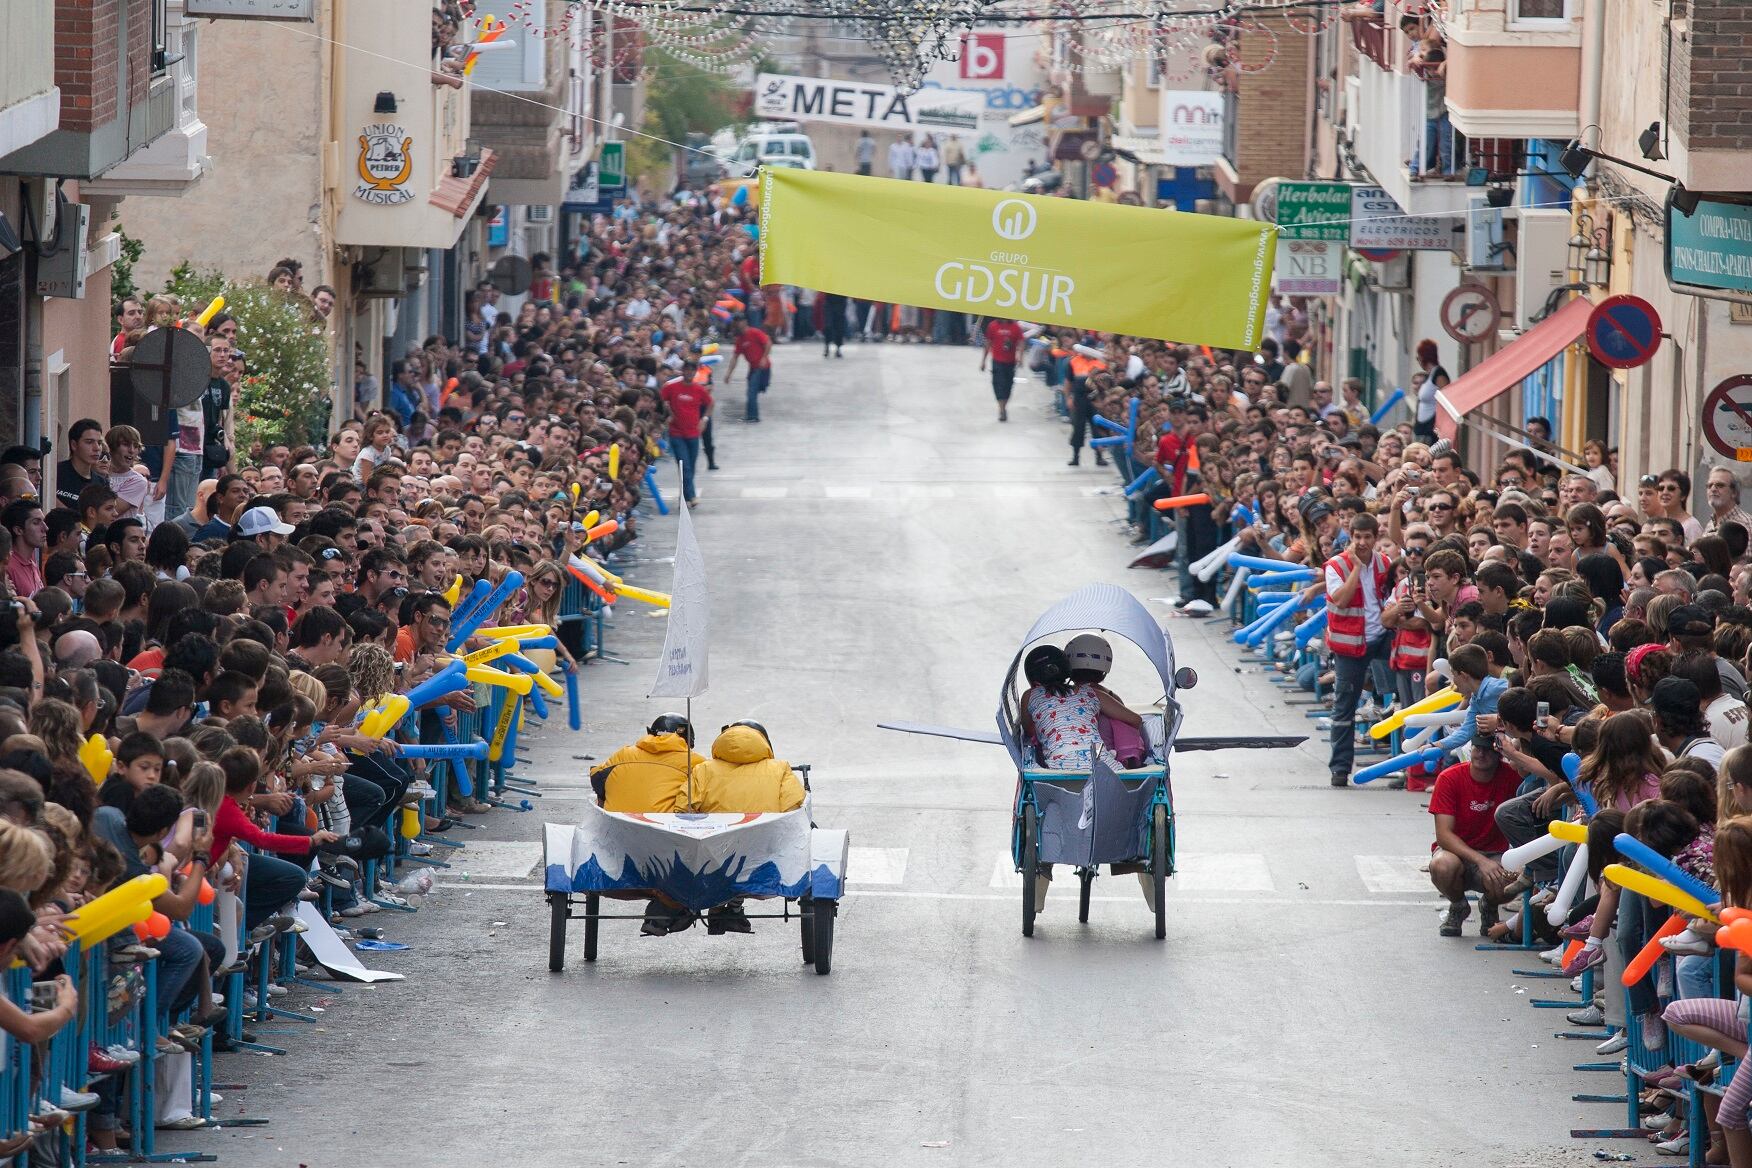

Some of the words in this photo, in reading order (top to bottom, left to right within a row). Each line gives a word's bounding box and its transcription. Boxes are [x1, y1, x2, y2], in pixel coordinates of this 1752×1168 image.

[792, 83, 911, 123] META
[353, 185, 416, 204] MUSICAL
[1279, 186, 1350, 204] Herbolar
[1360, 225, 1440, 235] ELECTRICOS
[1700, 214, 1752, 242] COMPRA-VENTA
[990, 251, 1028, 265] GRUPO
[1288, 255, 1328, 275] NB
[1674, 246, 1752, 279] PISOS-CHALETS-APARTA
[934, 262, 1075, 316] GDSUR
[1244, 227, 1269, 347] www.grupogdsur.com
